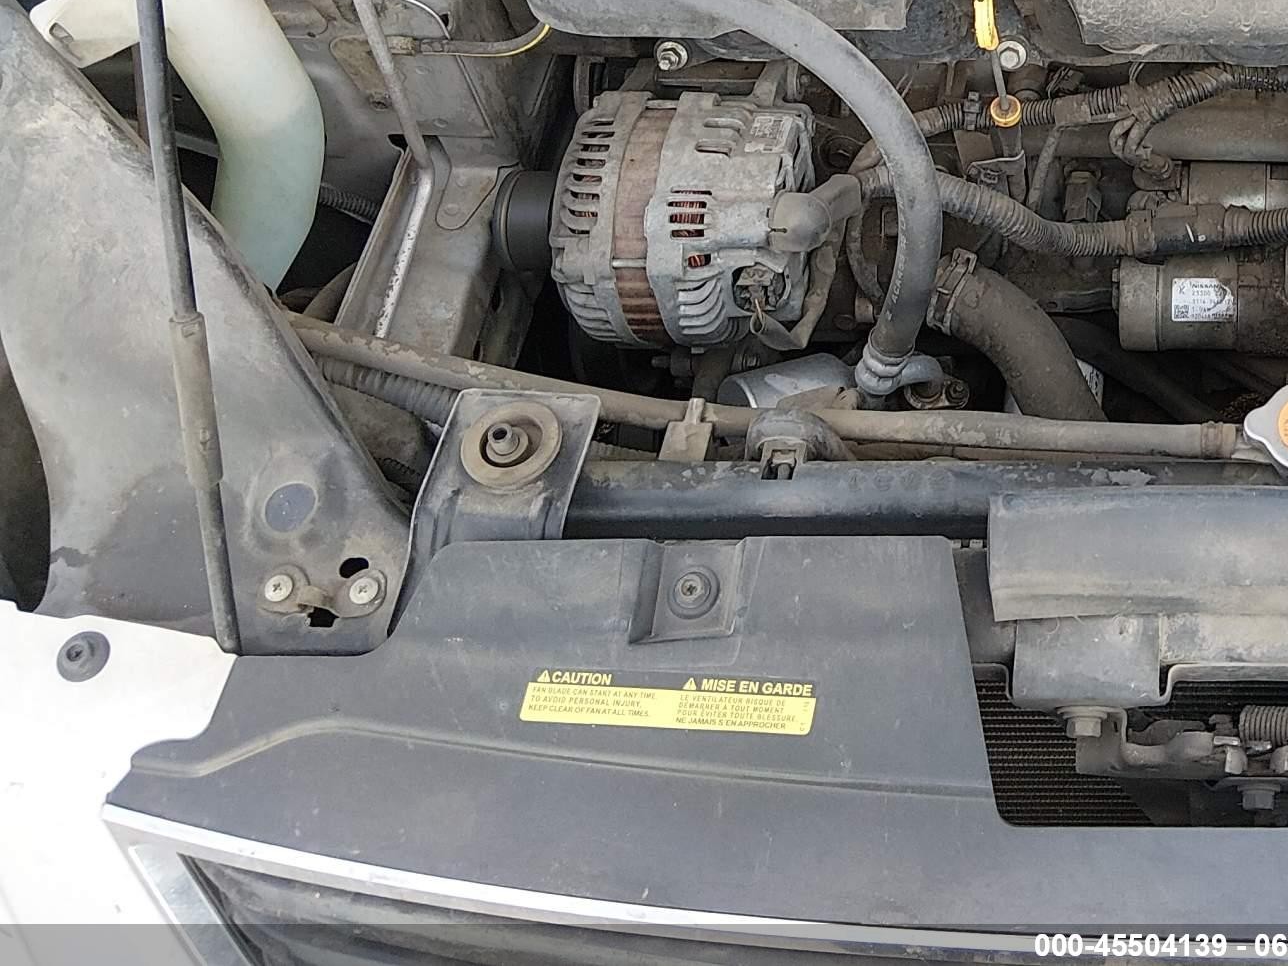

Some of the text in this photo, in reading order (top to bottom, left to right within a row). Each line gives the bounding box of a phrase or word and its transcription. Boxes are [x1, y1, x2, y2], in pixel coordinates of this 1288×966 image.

[551, 671, 613, 685] CAUTION
[701, 678, 813, 696] MISE EN GARDE
[543, 696, 567, 704] AVOID
[569, 697, 609, 706] PERSONAL
[688, 718, 717, 726] JAMAIS
